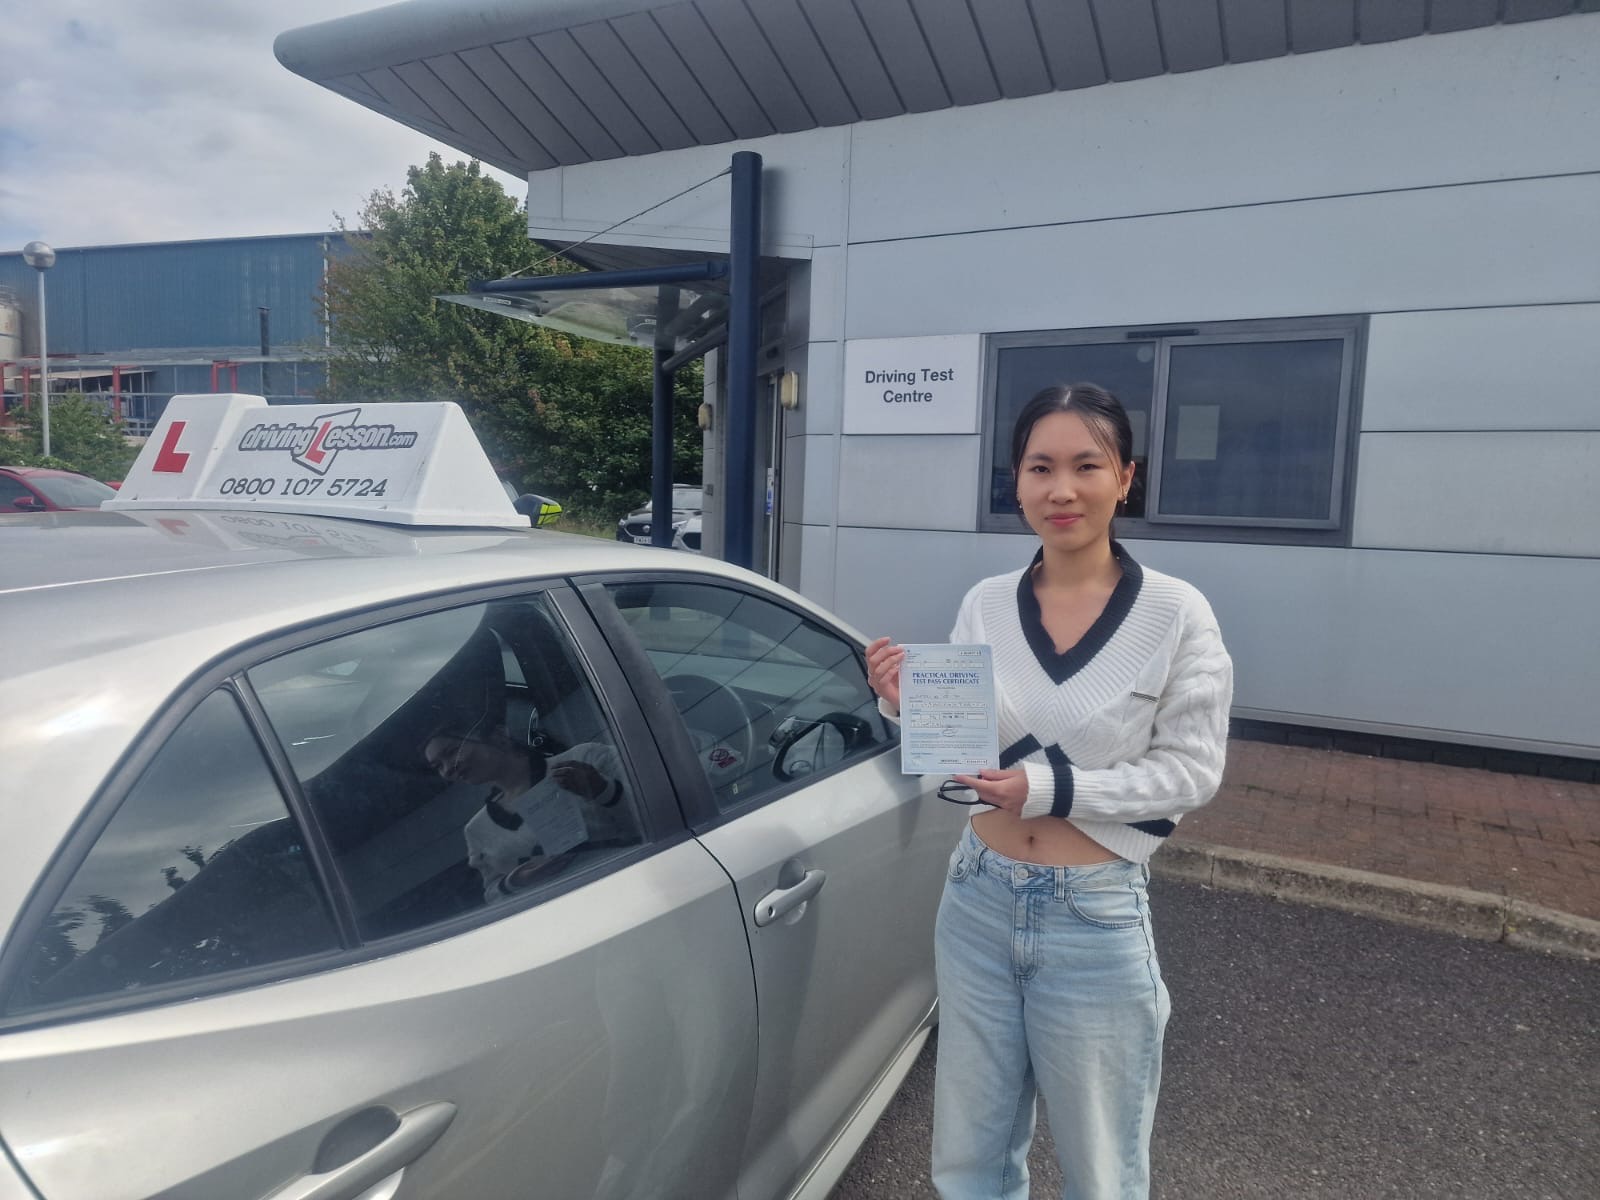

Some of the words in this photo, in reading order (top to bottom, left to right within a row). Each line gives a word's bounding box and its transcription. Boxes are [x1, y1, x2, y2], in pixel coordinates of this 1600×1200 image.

[865, 369, 916, 385] Driving
[921, 368, 954, 382] Test
[883, 390, 933, 403] Centre
[152, 421, 190, 473] L
[239, 419, 417, 466] drivingLesson.com
[219, 478, 275, 496] 0800
[280, 478, 322, 496] 107
[326, 478, 387, 497] 5724
